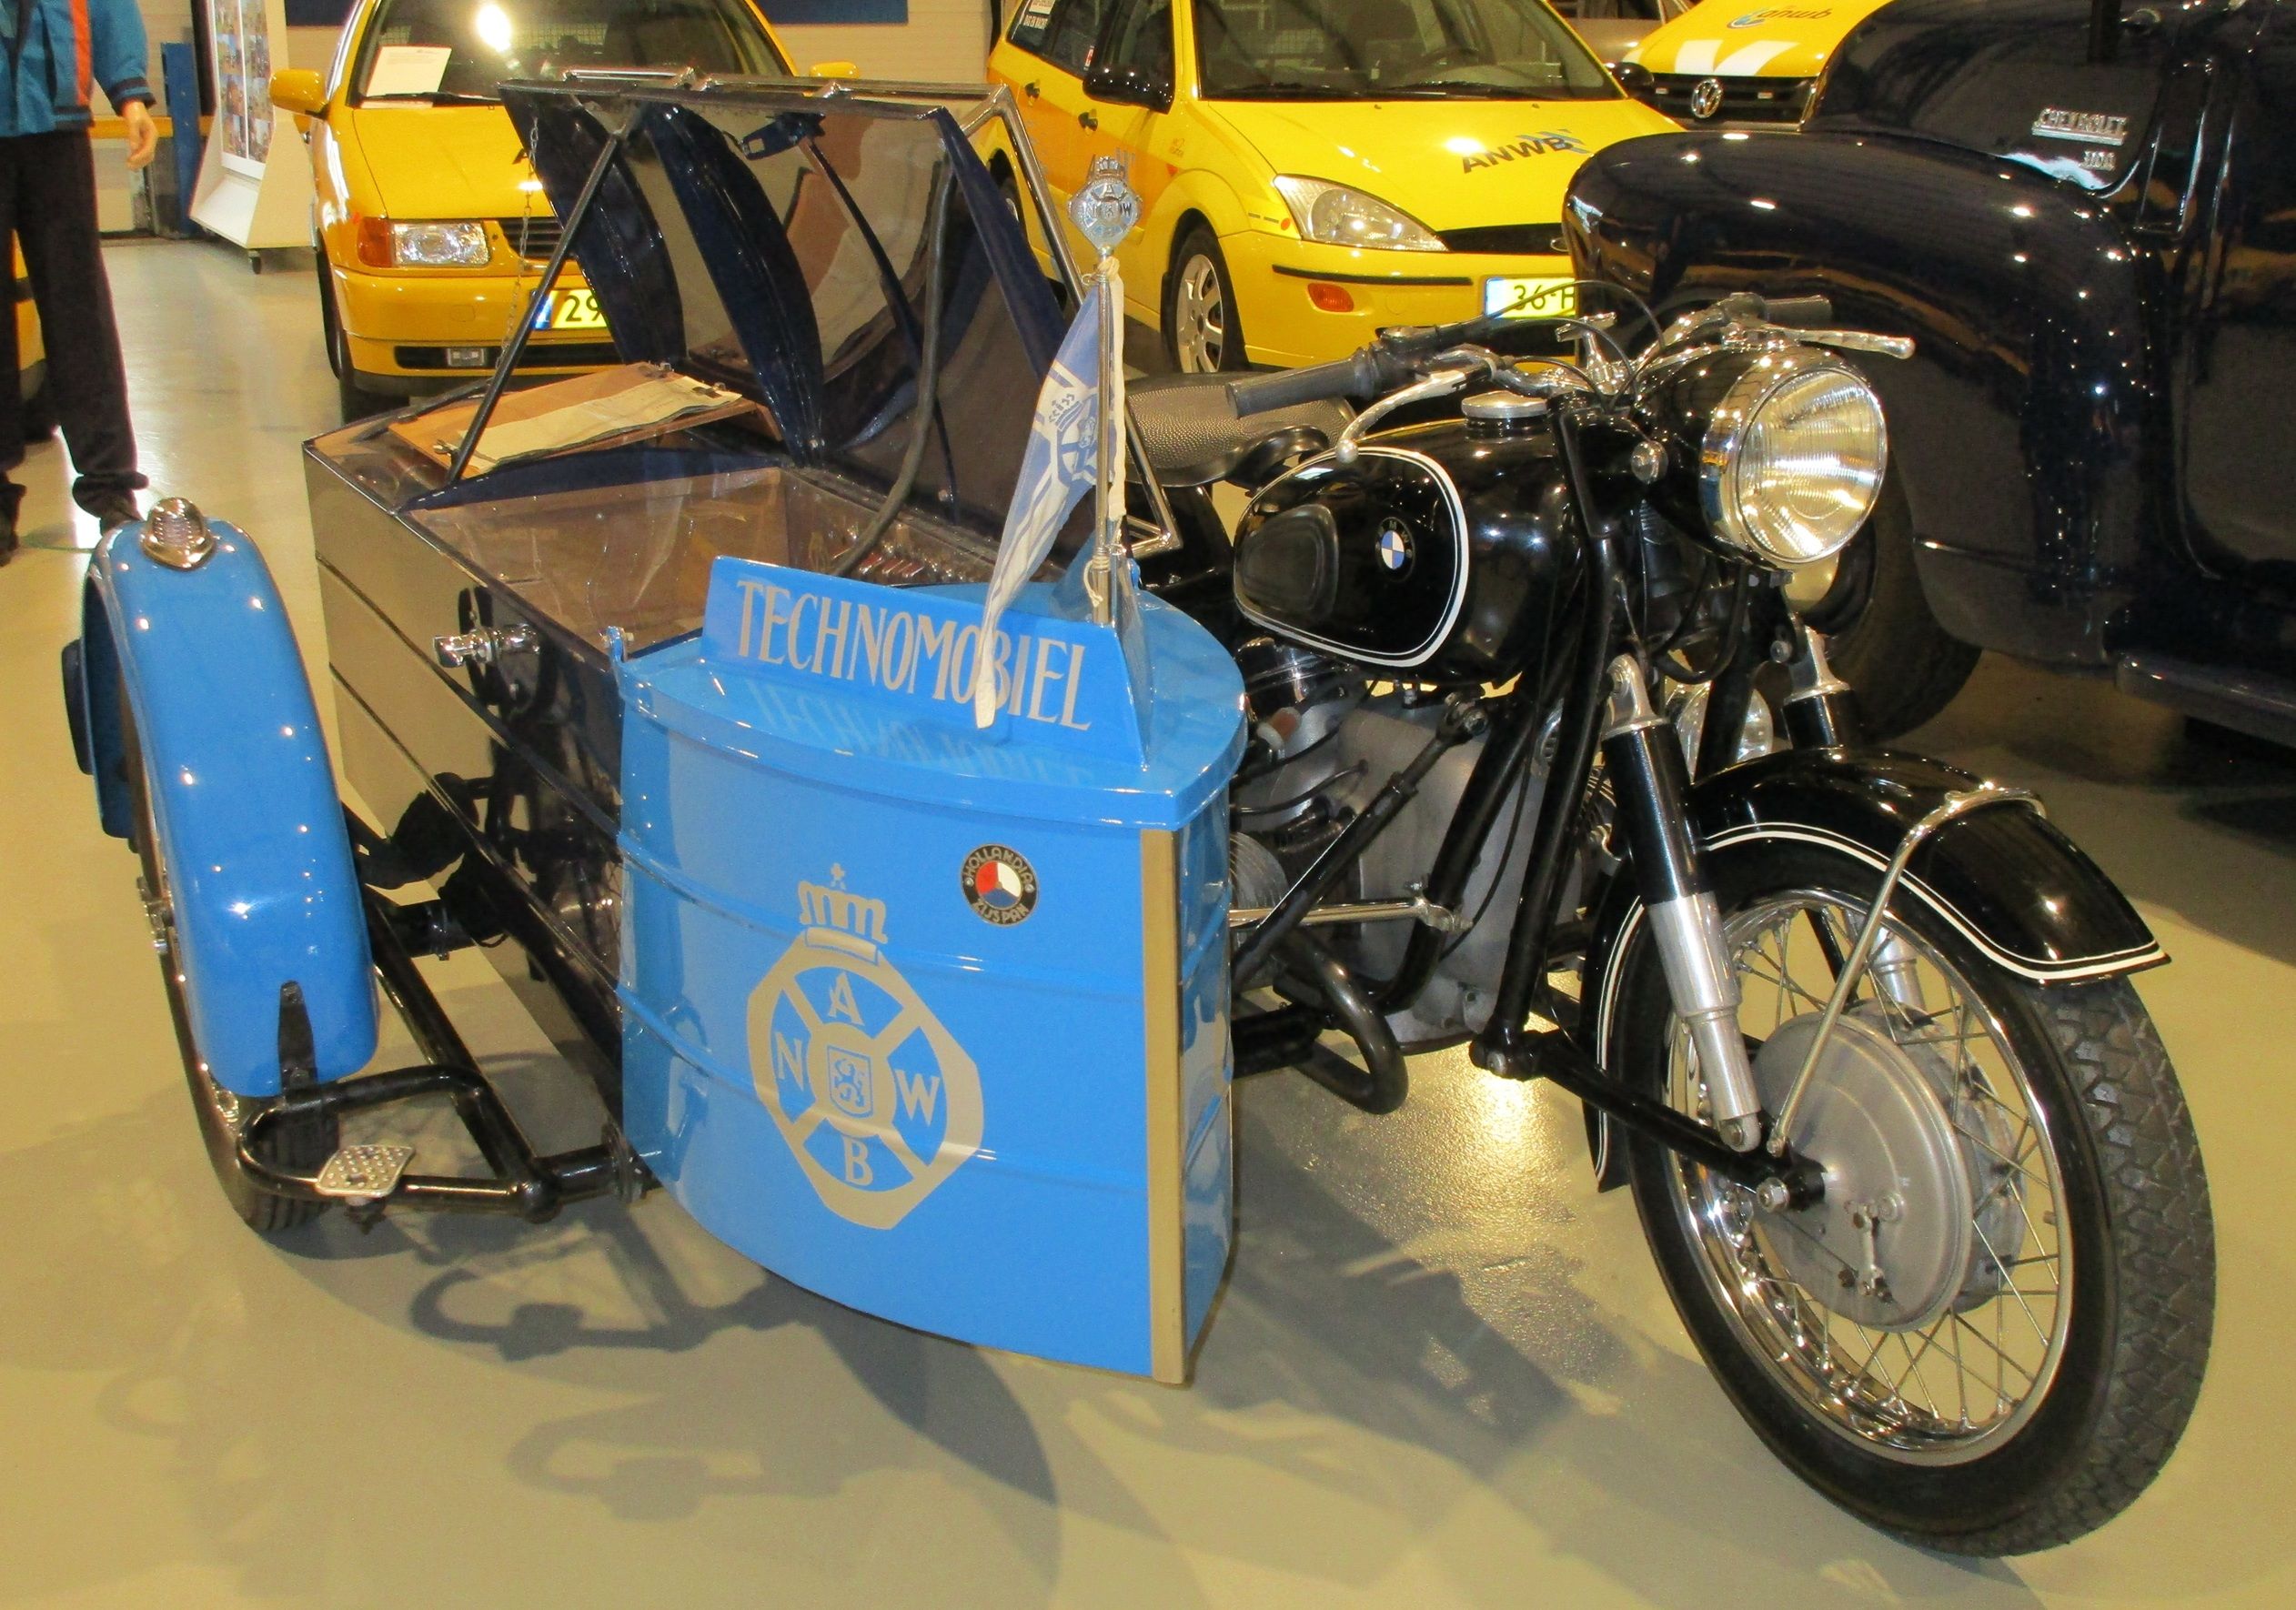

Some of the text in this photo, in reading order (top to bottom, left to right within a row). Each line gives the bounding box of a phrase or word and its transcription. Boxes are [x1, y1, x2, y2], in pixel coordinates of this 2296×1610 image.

[1462, 136, 1574, 174] ANWB
[735, 579, 1091, 731] TECHNOMOBIEL
[828, 971, 865, 1027] A
[775, 1031, 804, 1092] N
[895, 1068, 941, 1128] W
[842, 1135, 874, 1187] B
